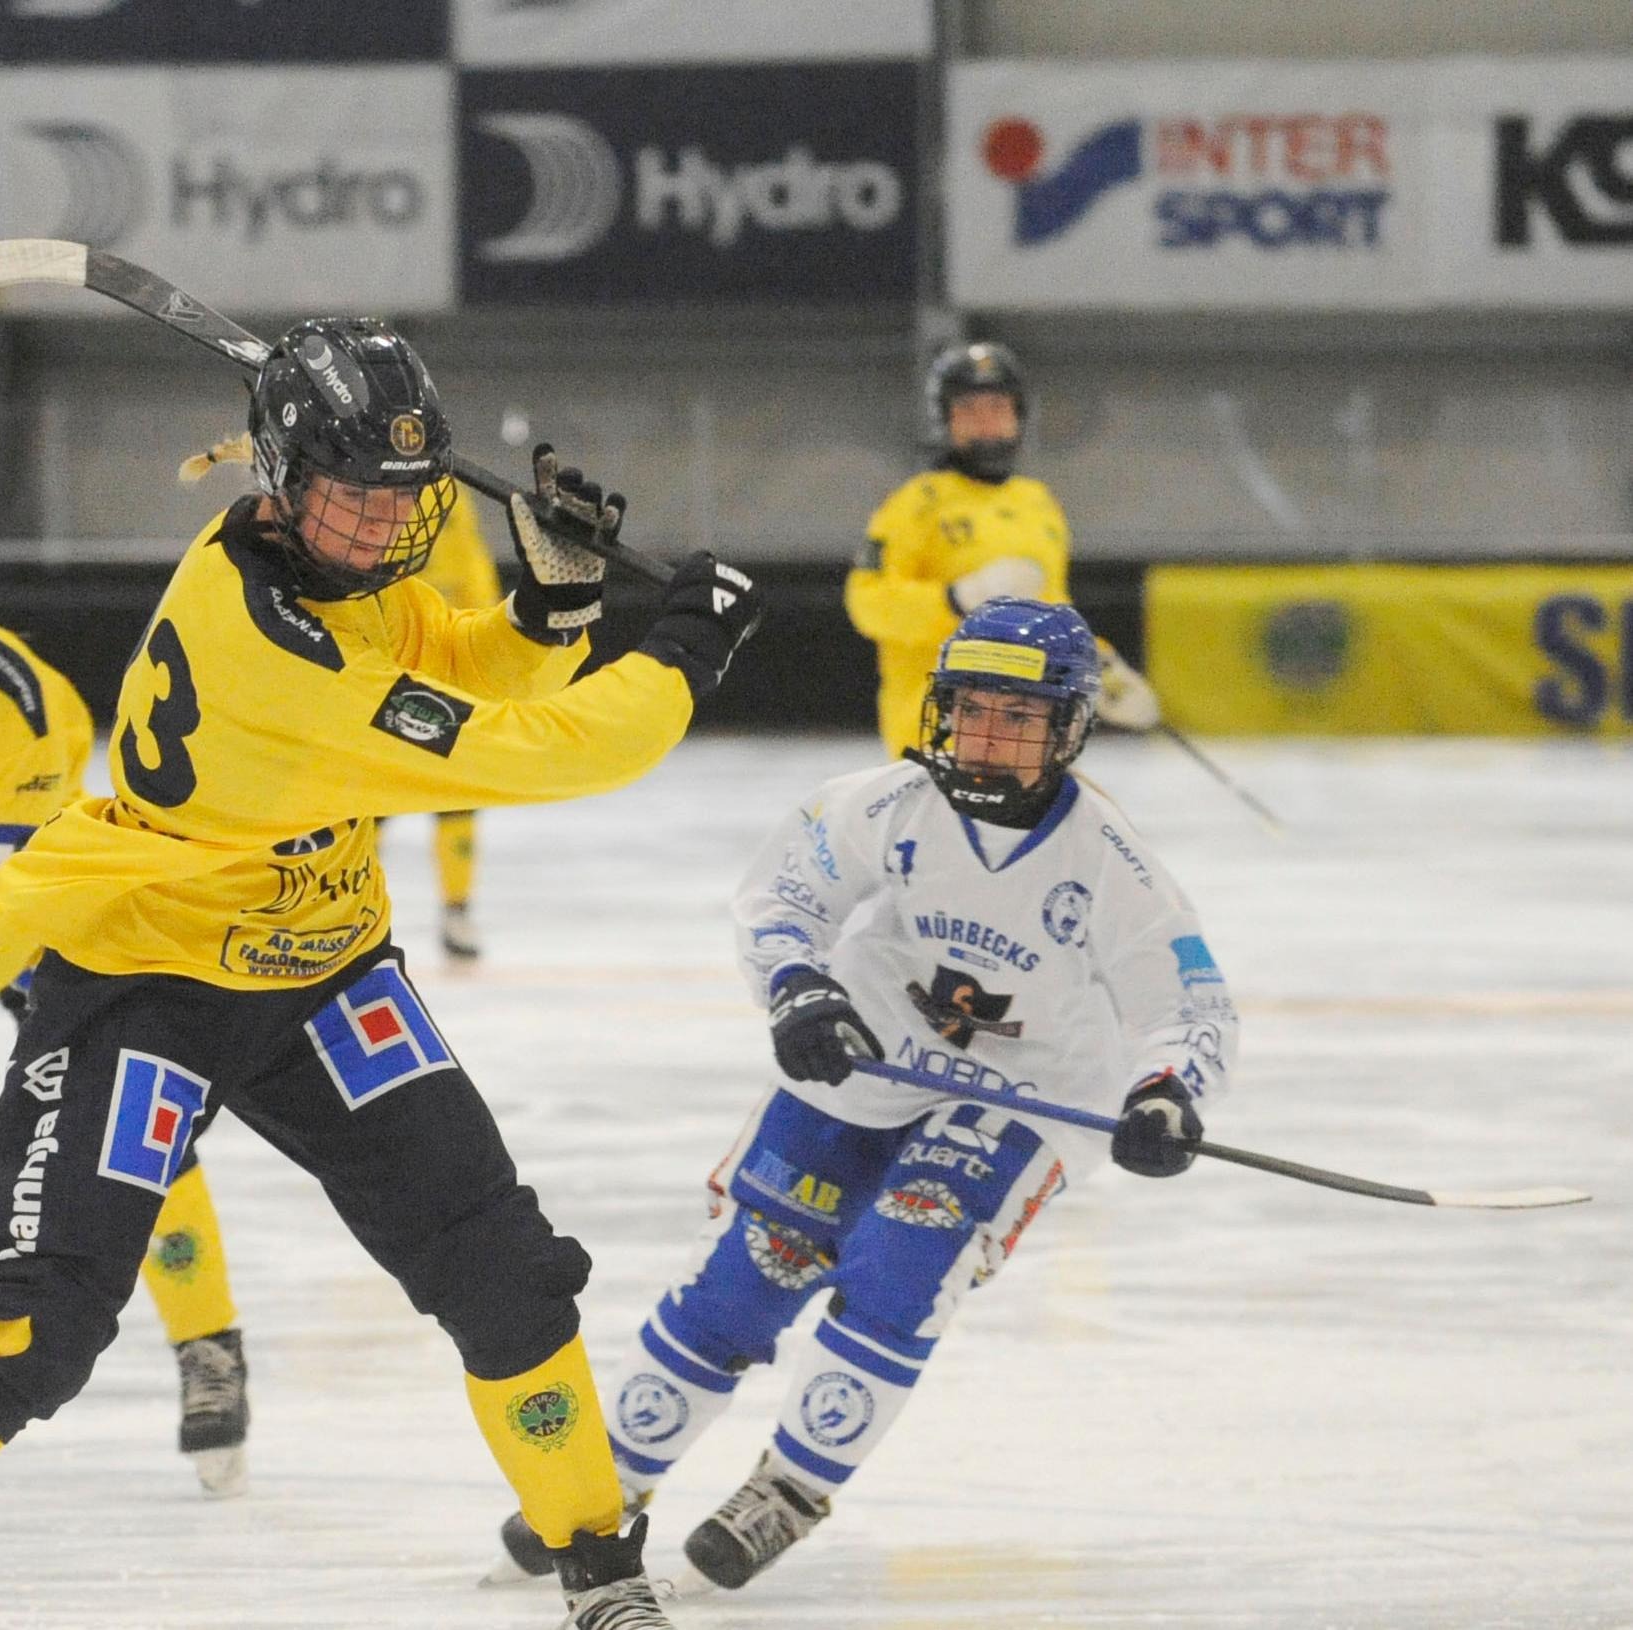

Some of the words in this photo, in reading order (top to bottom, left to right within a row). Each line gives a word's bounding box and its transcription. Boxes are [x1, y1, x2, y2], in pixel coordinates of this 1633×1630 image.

[1157, 113, 1390, 180] INTER
[170, 152, 425, 246] Hydro
[635, 144, 903, 248] Hydro
[1154, 189, 1389, 251] SPORT
[322, 364, 353, 404] Hydro
[380, 459, 431, 471] BAUER
[951, 788, 1006, 804] CCM
[1102, 825, 1145, 872] CRAFT
[915, 910, 1041, 972] MÜRBECKS
